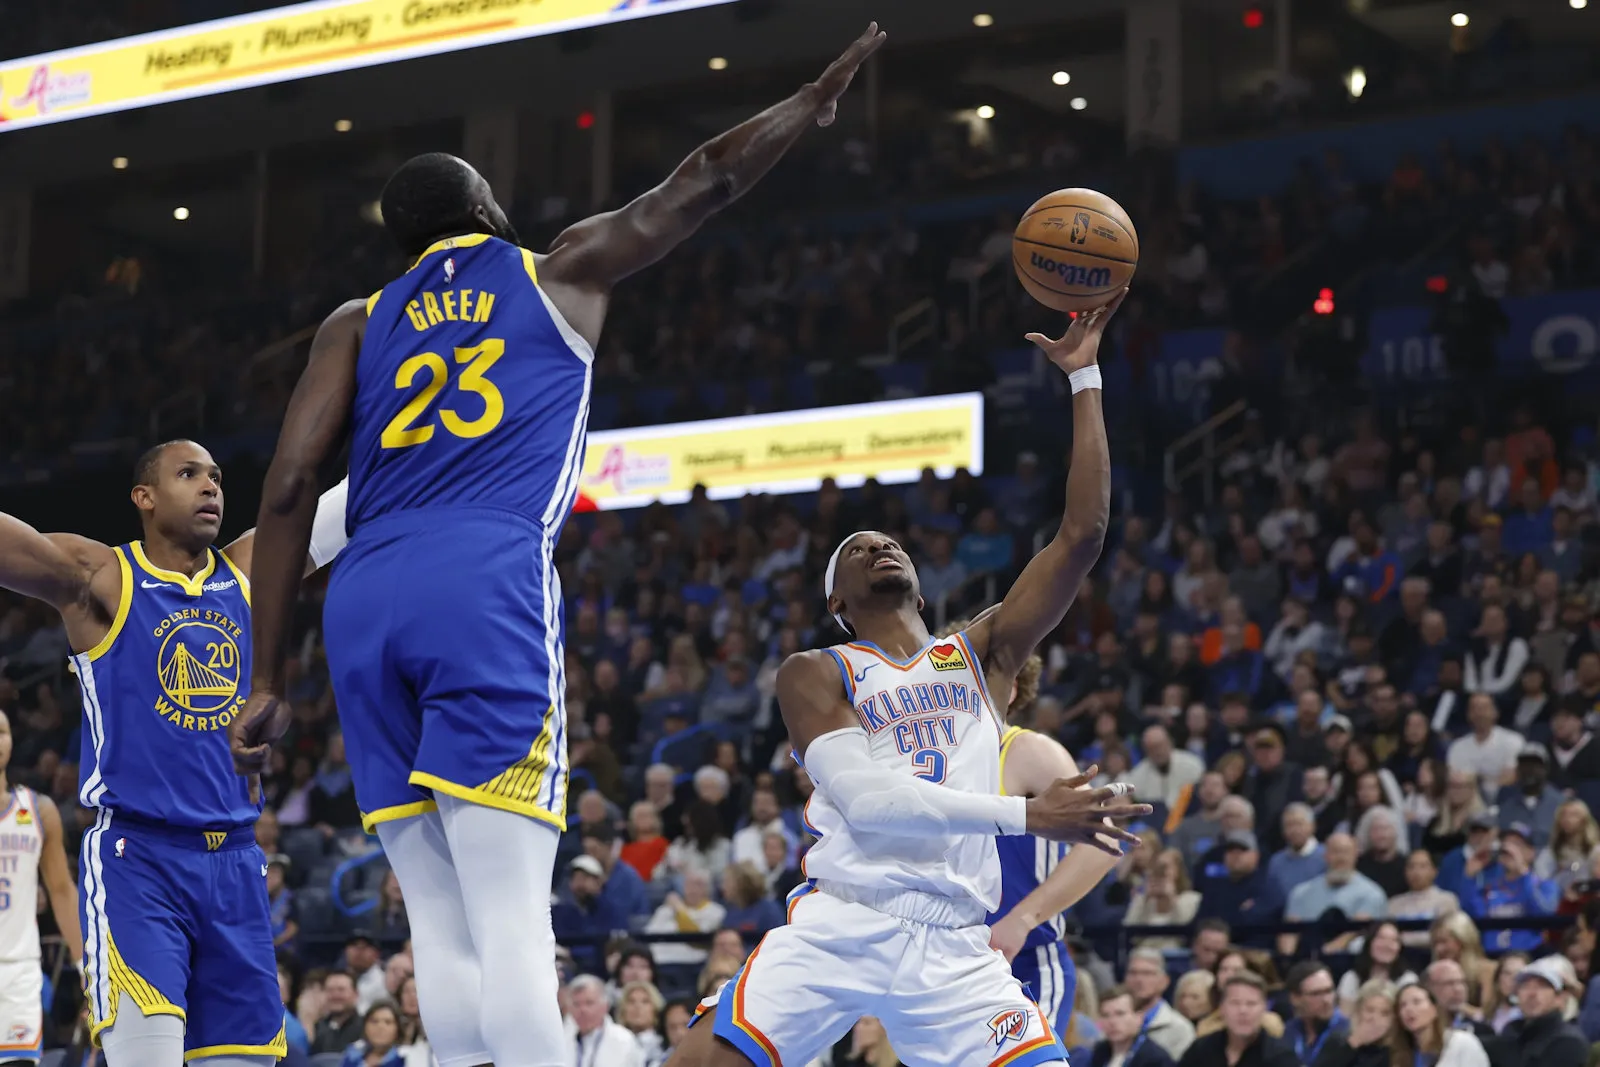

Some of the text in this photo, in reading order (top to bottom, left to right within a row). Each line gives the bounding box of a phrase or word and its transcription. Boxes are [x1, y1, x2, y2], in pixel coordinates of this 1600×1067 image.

[144, 42, 233, 75] Heating
[261, 15, 372, 53] Plumbing
[1030, 251, 1112, 287] Wilson
[405, 289, 495, 331] GREEN
[380, 338, 505, 449] 23
[202, 579, 238, 592] Rakuten
[154, 608, 243, 638] GOLDEN STATE
[205, 642, 235, 669] 20
[154, 695, 247, 731] WARRIORS
[893, 716, 957, 755] CITY
[912, 747, 947, 785] 2
